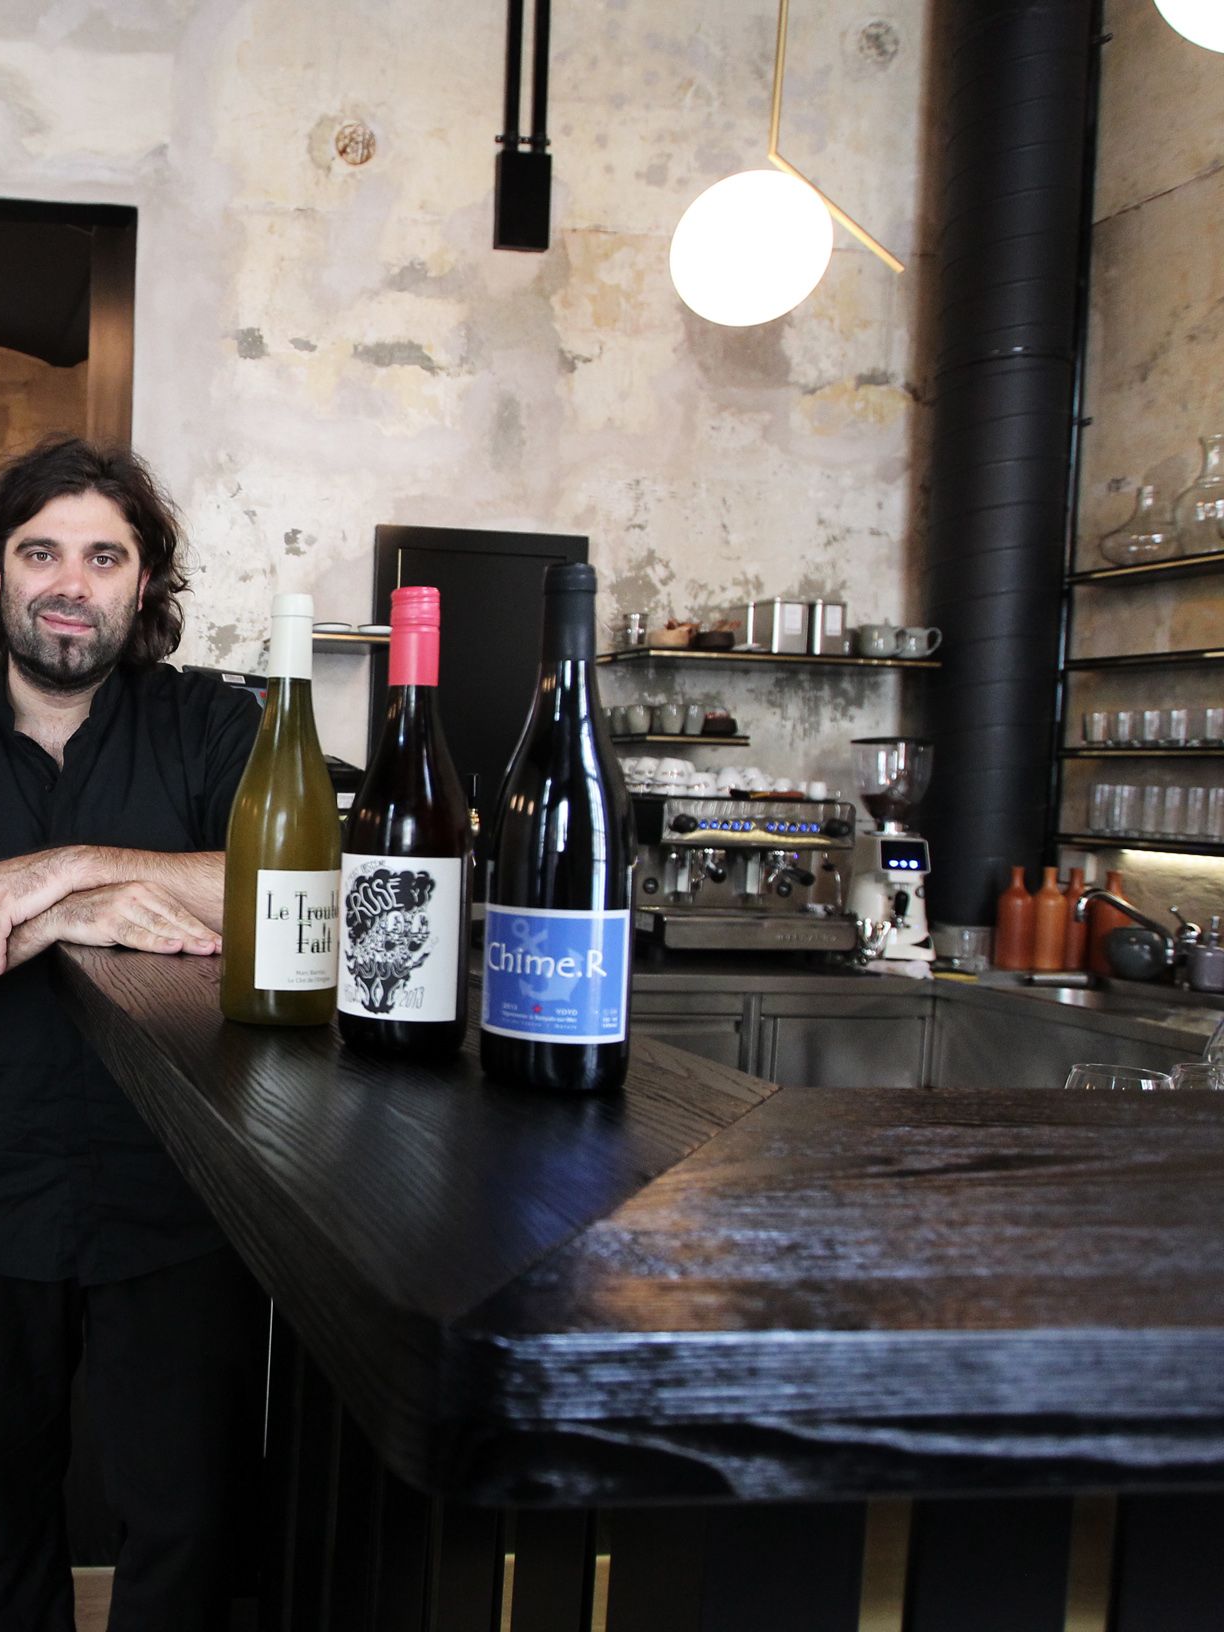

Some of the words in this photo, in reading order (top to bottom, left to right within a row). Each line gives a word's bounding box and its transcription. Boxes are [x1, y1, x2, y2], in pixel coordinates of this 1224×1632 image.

[266, 889, 290, 920] Le
[295, 890, 340, 920] Troubl
[296, 921, 332, 954] Fait
[488, 942, 607, 979] Chime.R
